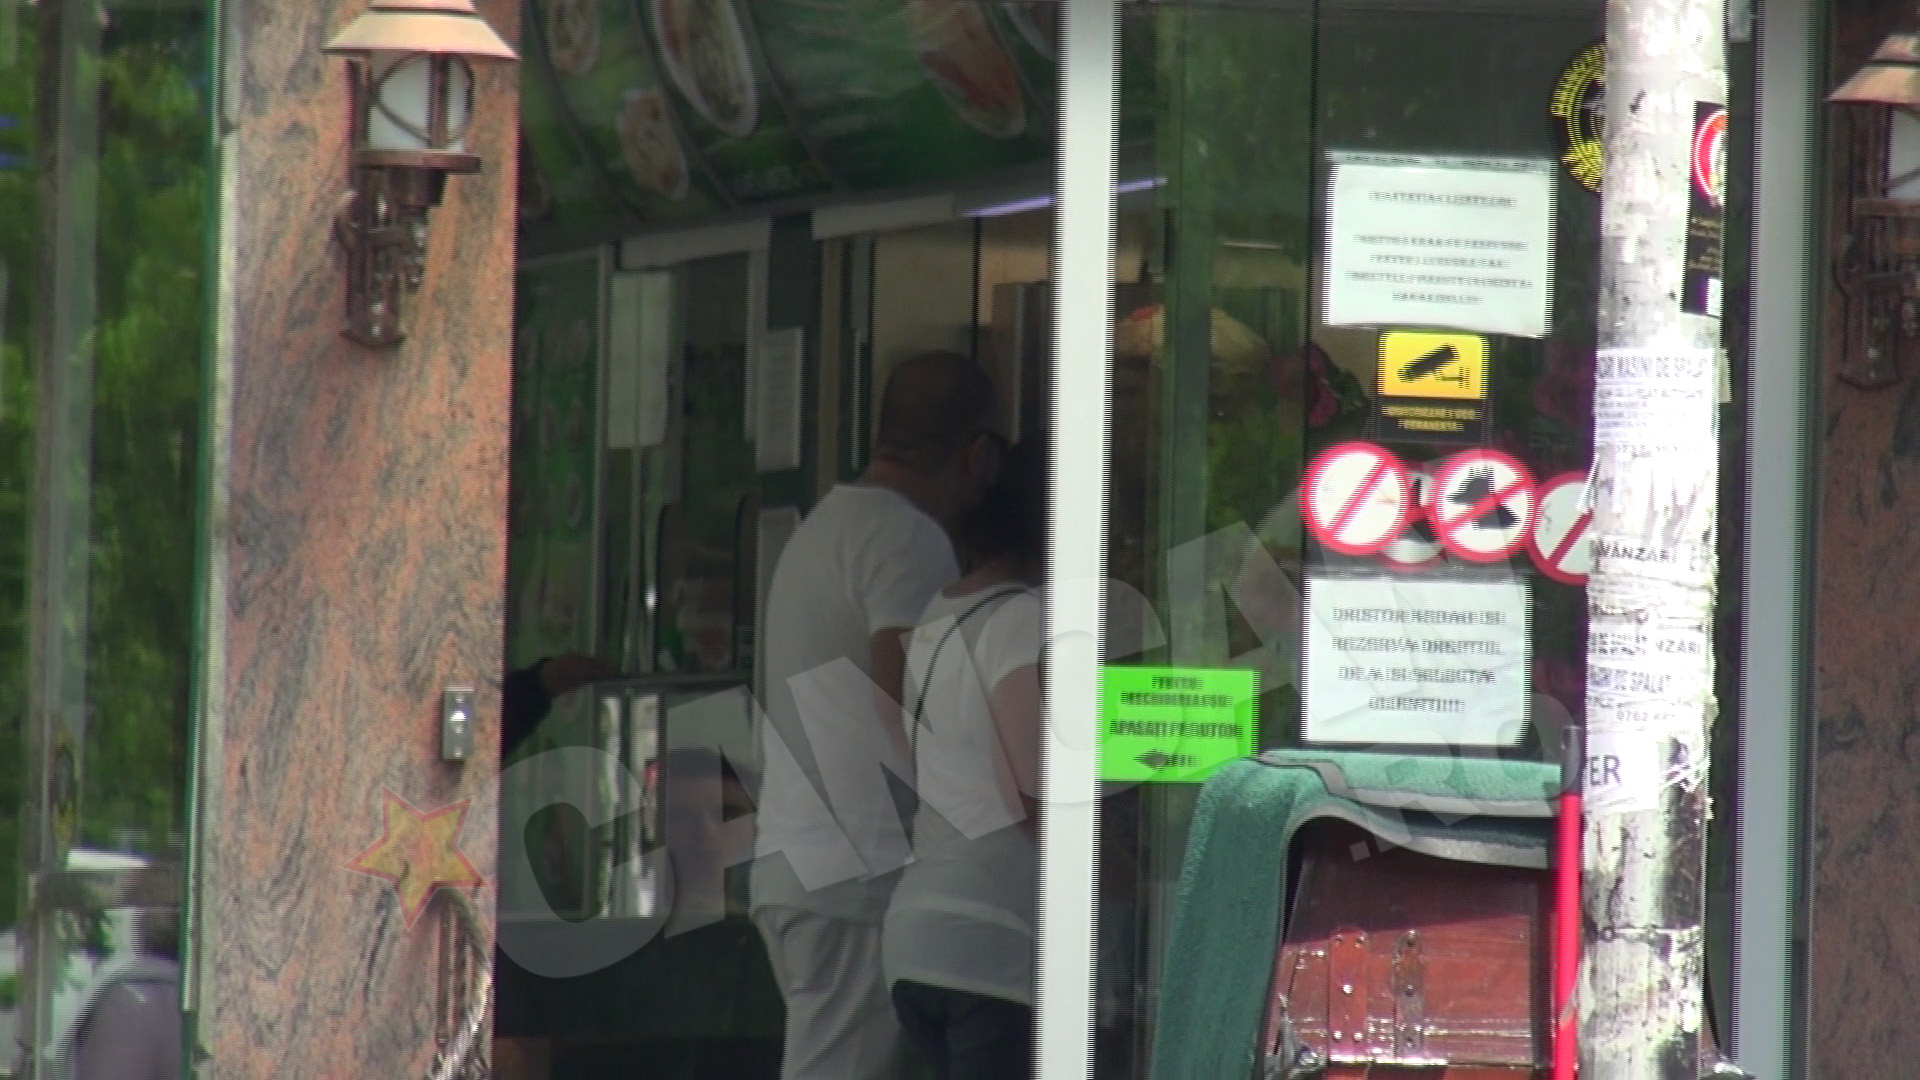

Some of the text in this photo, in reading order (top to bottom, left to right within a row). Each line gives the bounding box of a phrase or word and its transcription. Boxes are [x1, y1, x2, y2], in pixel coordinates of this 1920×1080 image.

[1333, 607, 1506, 626] DRISTOR KEBAB ISI
[1332, 636, 1506, 656] REZERVA DREPTUL
[1152, 676, 1203, 690] PENTRU
[1338, 666, 1497, 685] DE A ISI SELECTA
[1171, 722, 1192, 738] PE
[1191, 722, 1243, 739] BUTON
